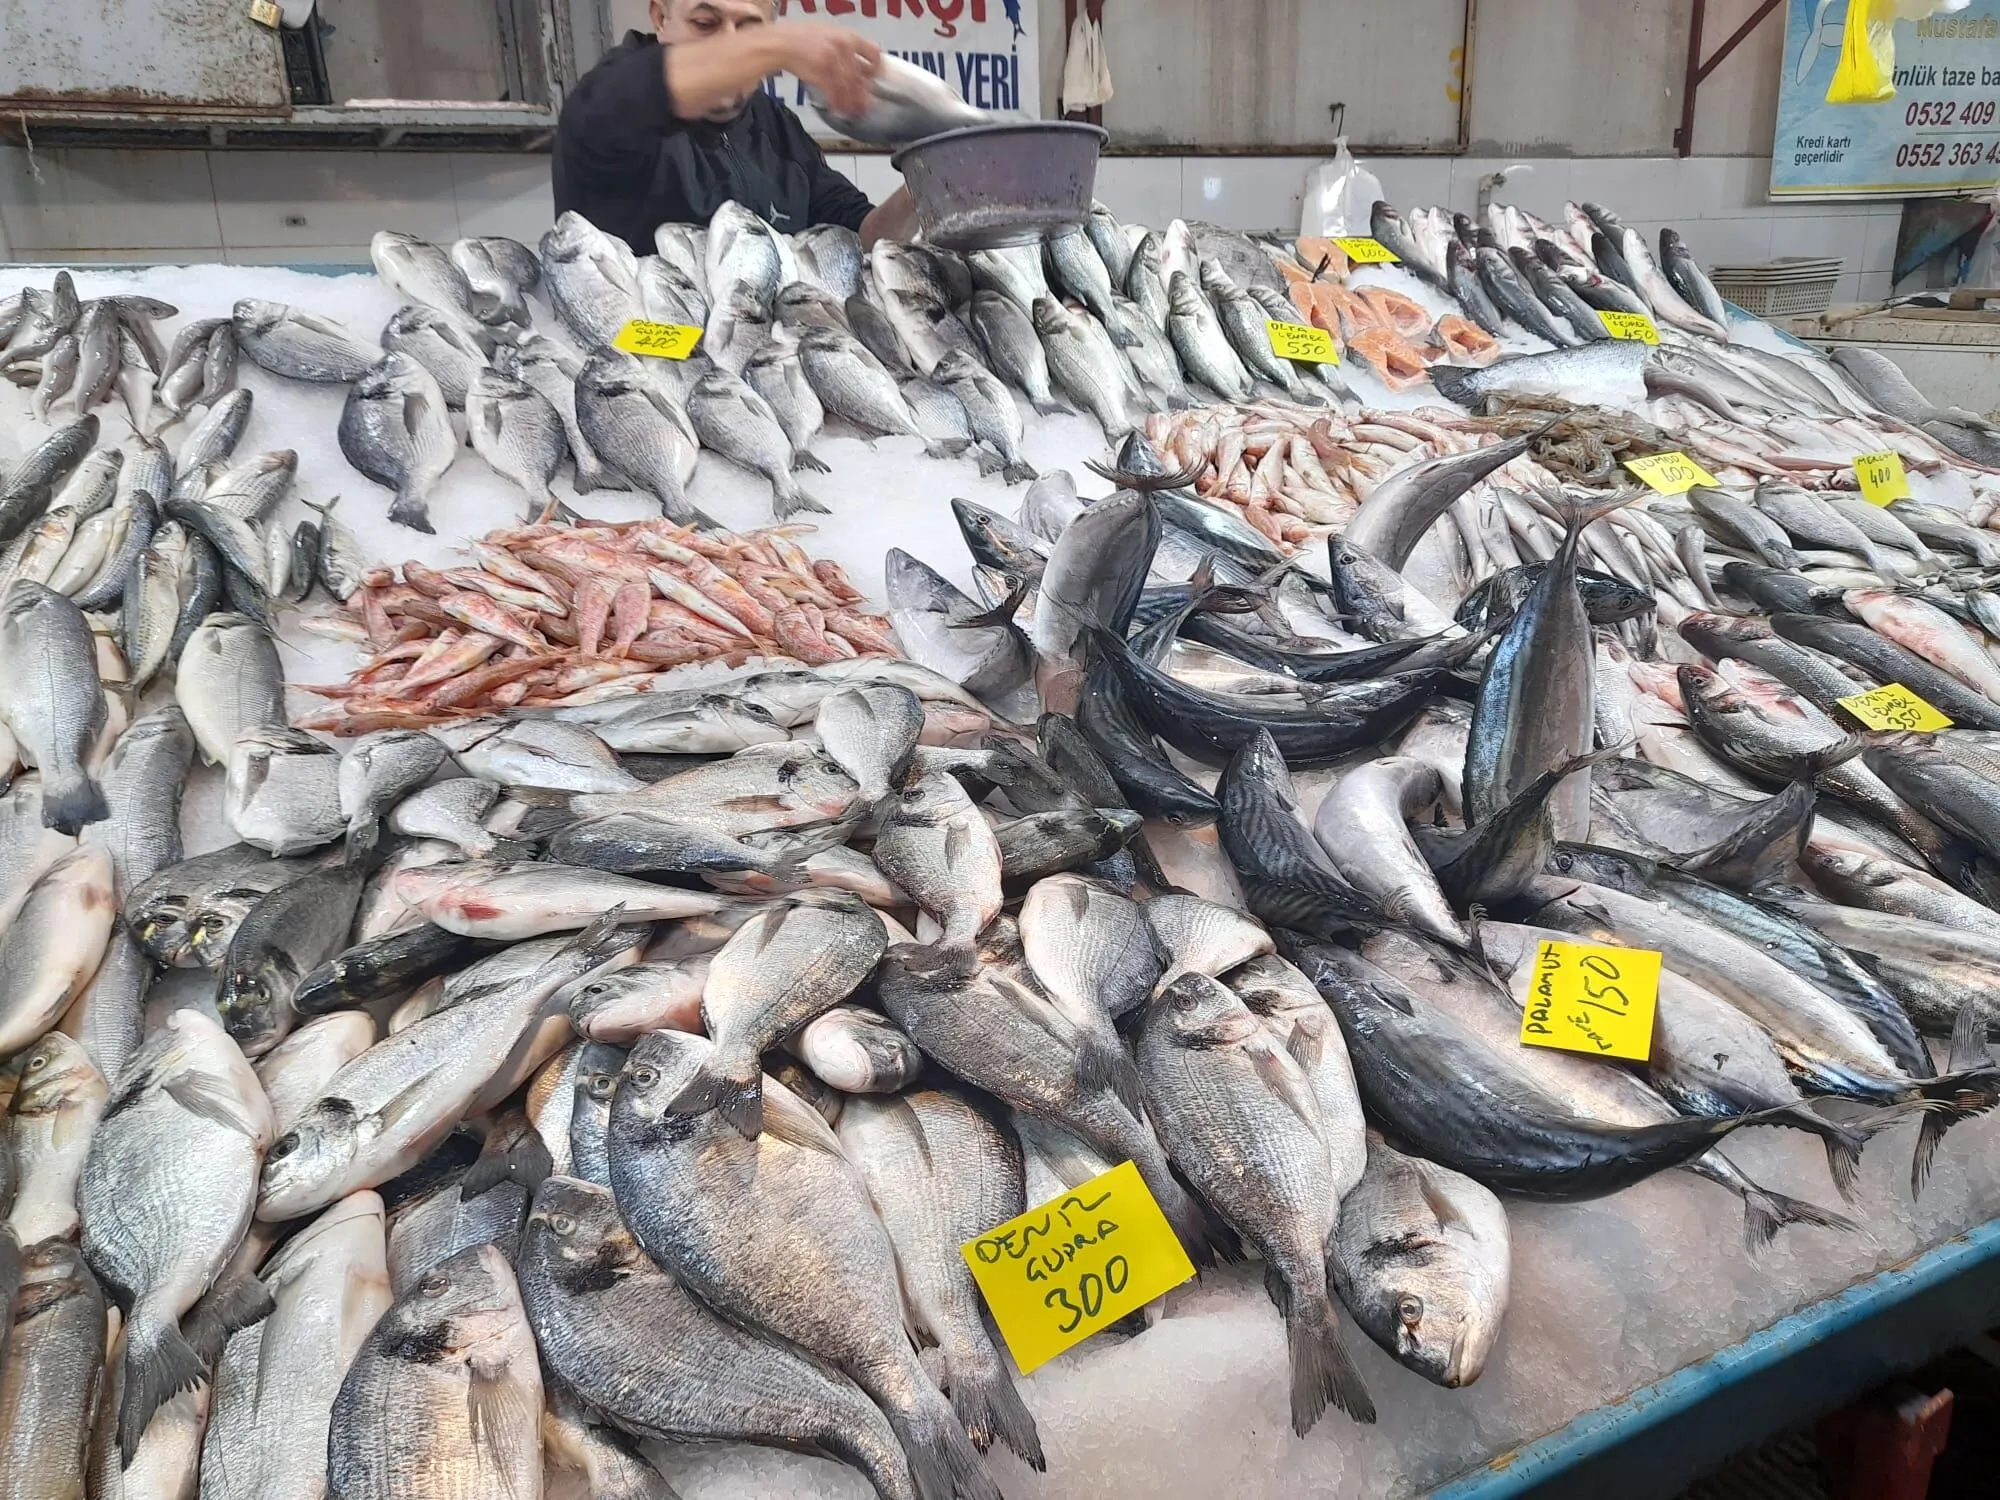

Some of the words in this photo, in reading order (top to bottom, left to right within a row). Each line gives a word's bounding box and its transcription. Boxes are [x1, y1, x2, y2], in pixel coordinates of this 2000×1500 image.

[955, 43, 1020, 110] YERİ
[1942, 66, 1976, 86] taze
[1905, 101, 1956, 126] 0532
[1959, 101, 1996, 125] 409
[1796, 135, 1825, 149] Kredi
[1827, 135, 1852, 149] kartı
[1794, 149, 1845, 166] geçerlidir
[1896, 143, 1945, 168] 0552
[1948, 142, 1984, 165] 363
[634, 335, 679, 349] 400
[1287, 341, 1327, 355] 550
[1660, 466, 1695, 483] 600
[1870, 466, 1891, 489] 400
[1886, 708, 1922, 731] 350
[1526, 943, 1562, 1034] PALAMUT
[1577, 955, 1630, 1017] 150
[1044, 1255, 1129, 1334] 300
